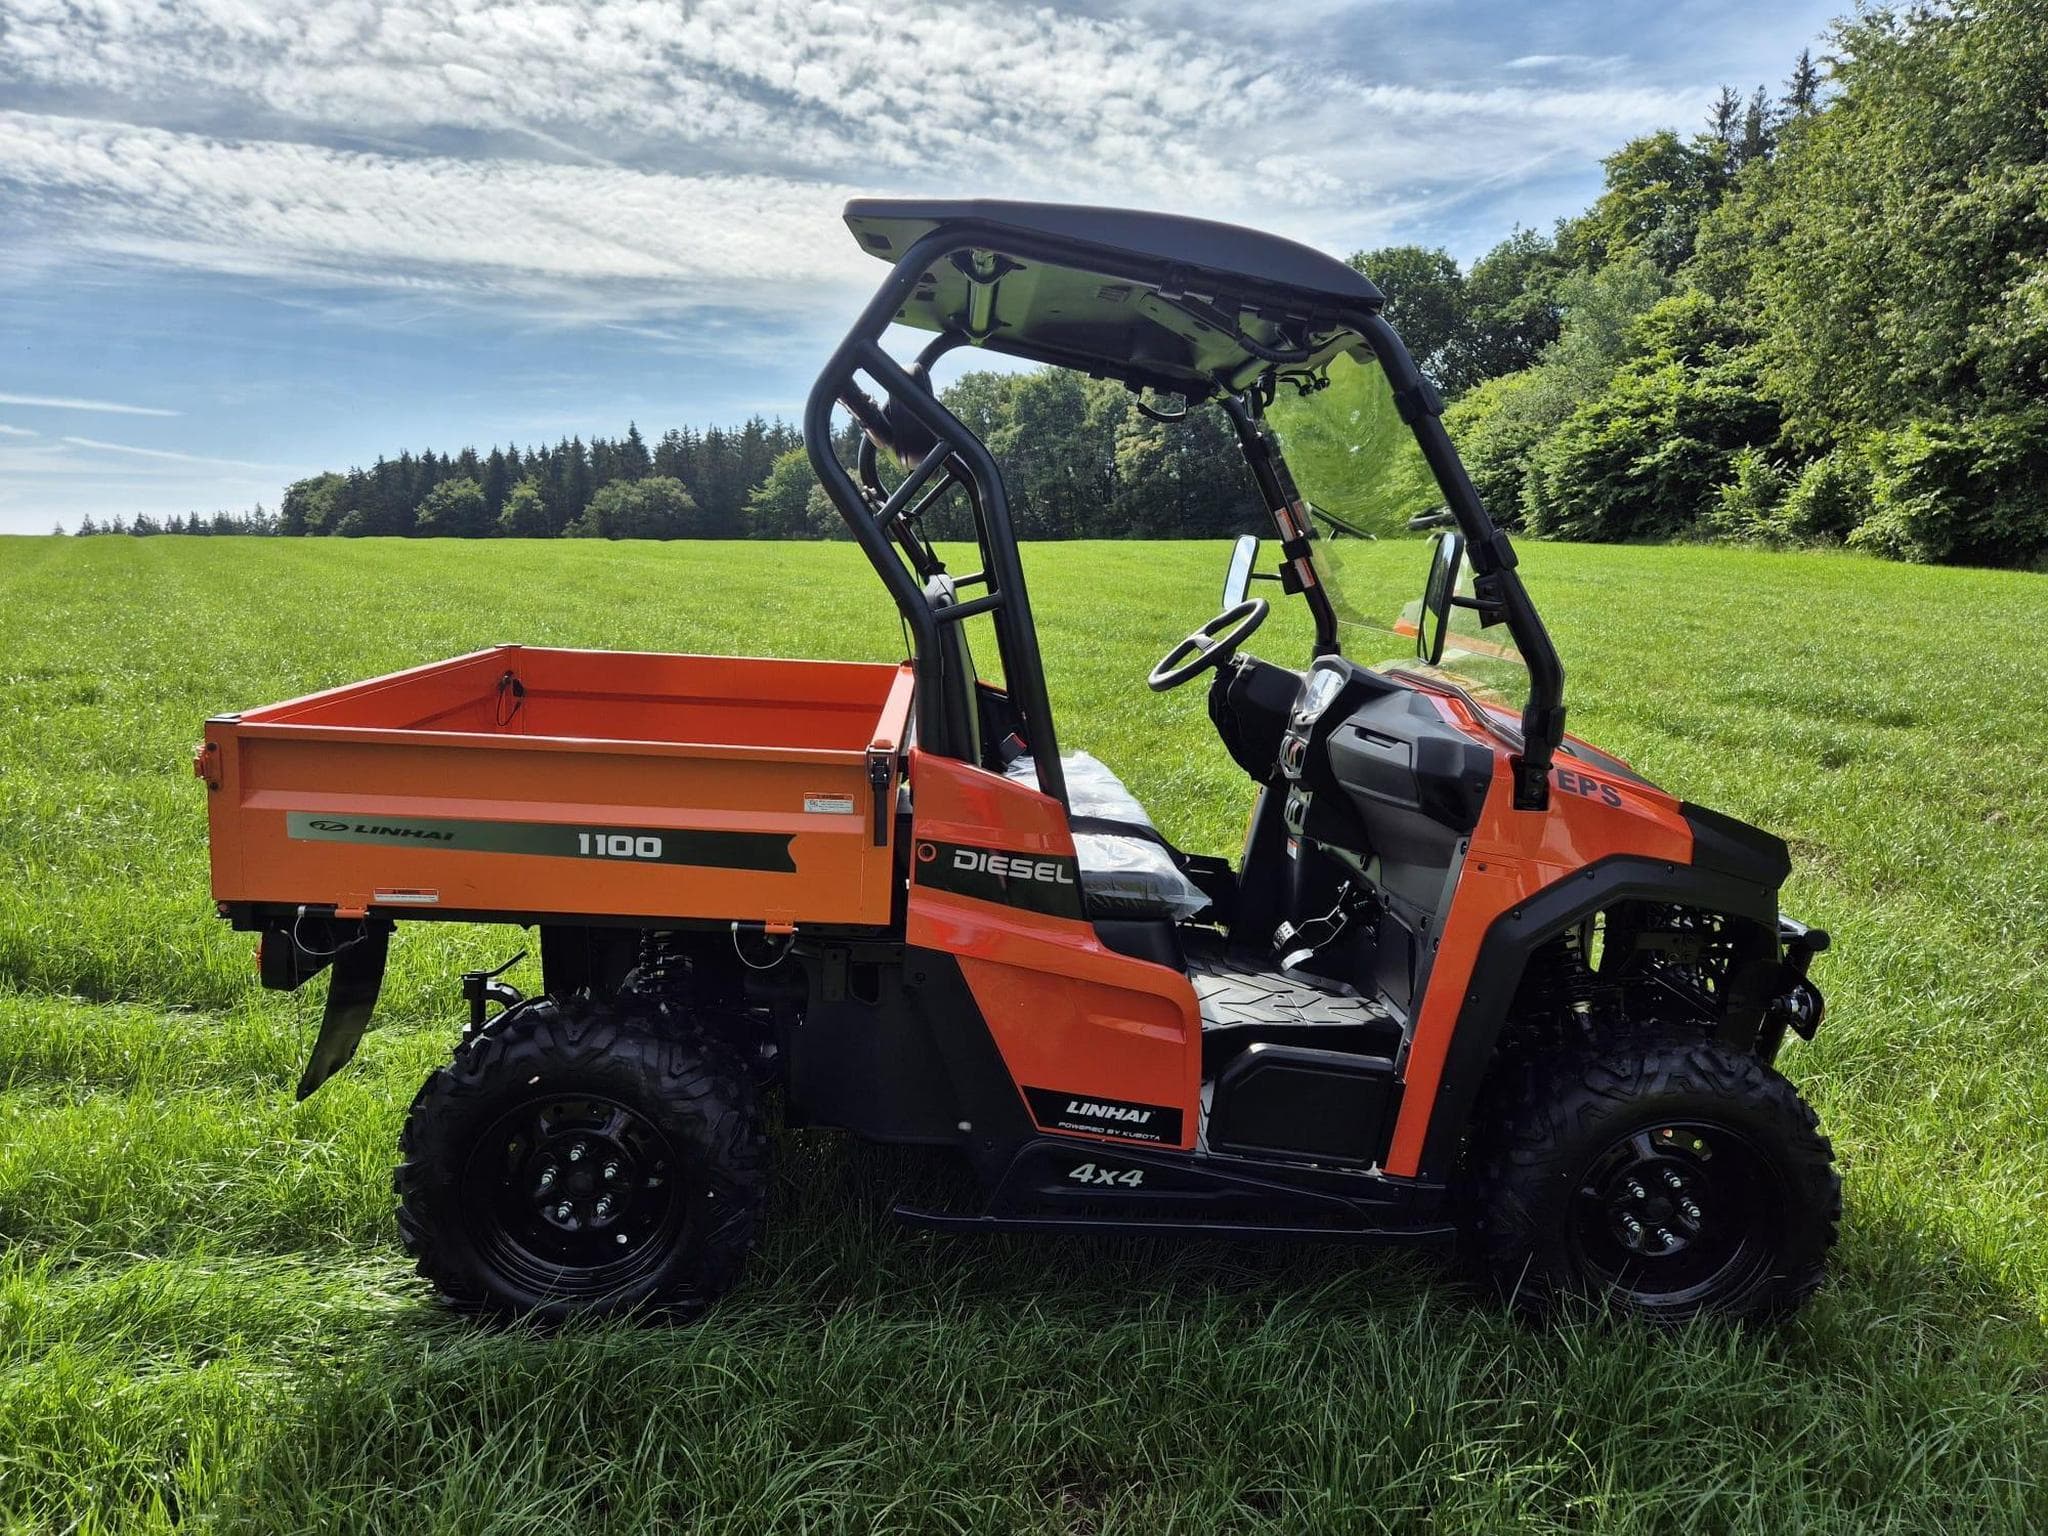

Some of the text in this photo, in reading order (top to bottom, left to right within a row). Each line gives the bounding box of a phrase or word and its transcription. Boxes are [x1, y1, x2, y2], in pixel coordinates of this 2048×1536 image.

[1556, 768, 1622, 807] EPS
[354, 824, 454, 841] LINHAI
[578, 833, 662, 858] 1100
[953, 849, 1074, 884] DIESEL
[1066, 1101, 1152, 1123] LINHAI
[1058, 1121, 1160, 1141] POWERED BY KUBOTA
[1068, 1163, 1144, 1187] 4x4
